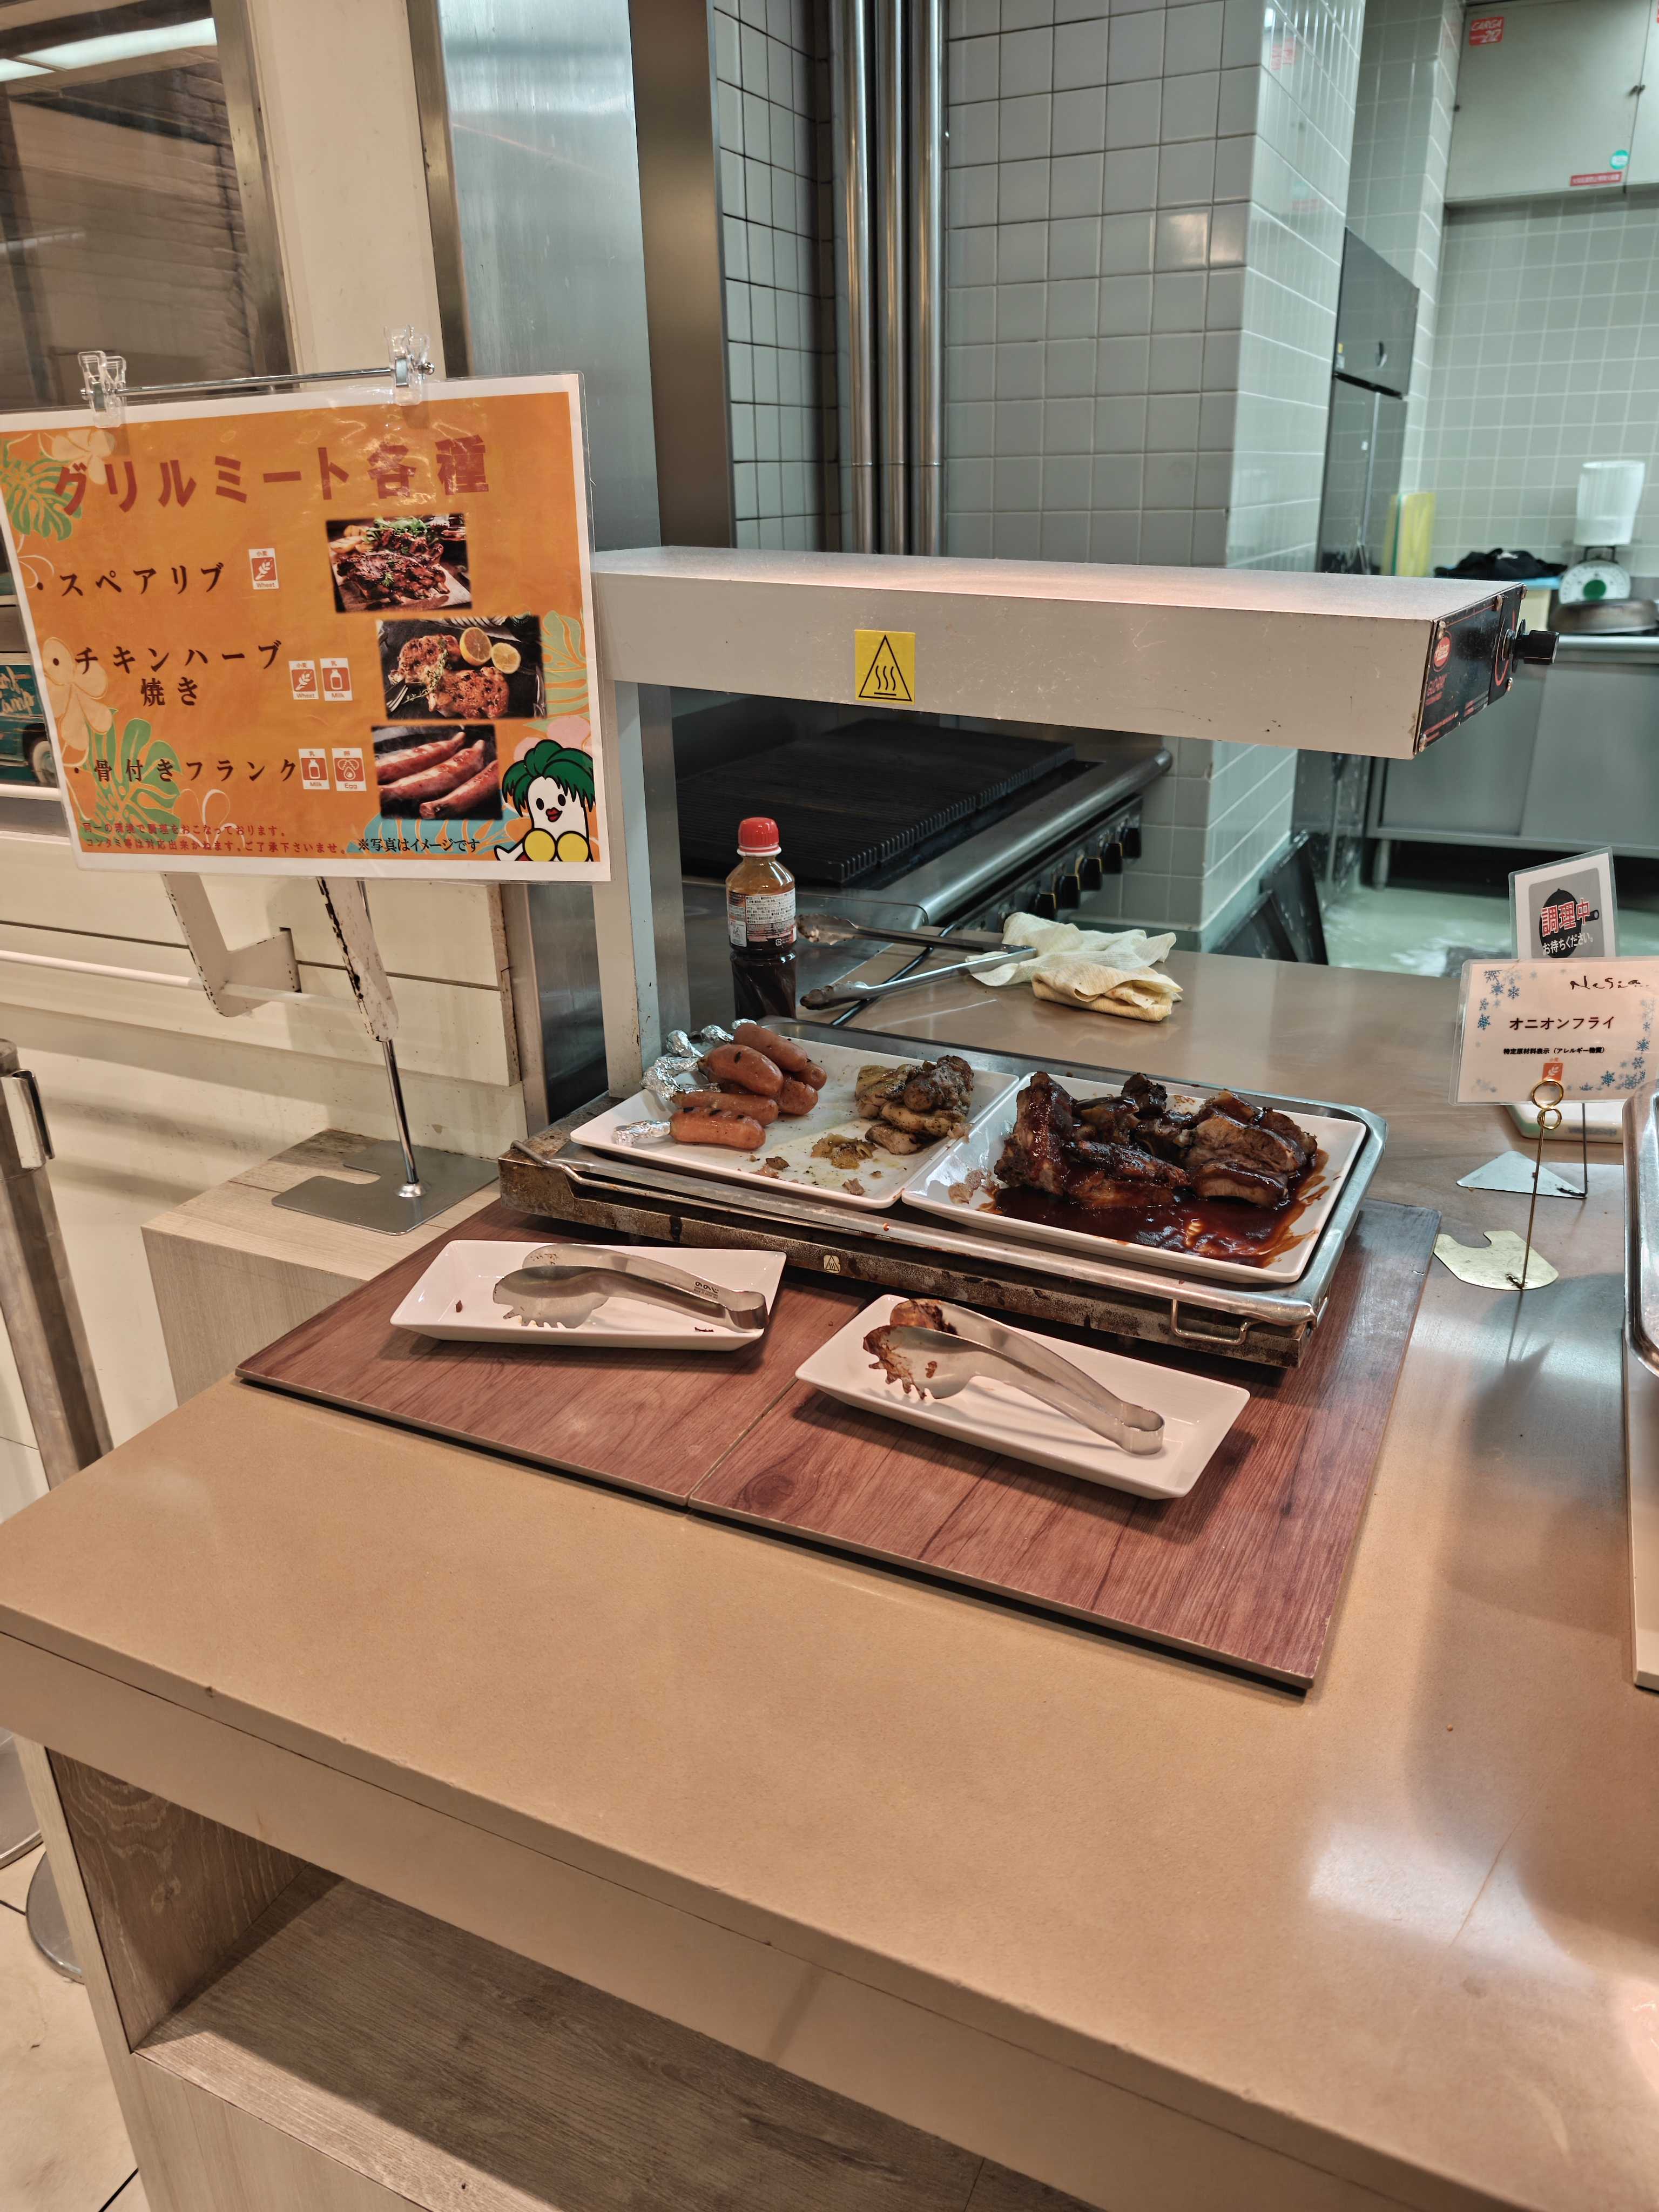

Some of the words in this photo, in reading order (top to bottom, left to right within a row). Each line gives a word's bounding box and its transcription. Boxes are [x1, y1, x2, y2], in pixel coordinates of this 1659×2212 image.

[55, 435, 489, 516] グリルミート各種
[140, 677, 198, 706] 焼き
[1541, 897, 1590, 937] 調理中
[1543, 932, 1593, 955] お待ちください。
[1509, 1016, 1614, 1030] オニオンフライ
